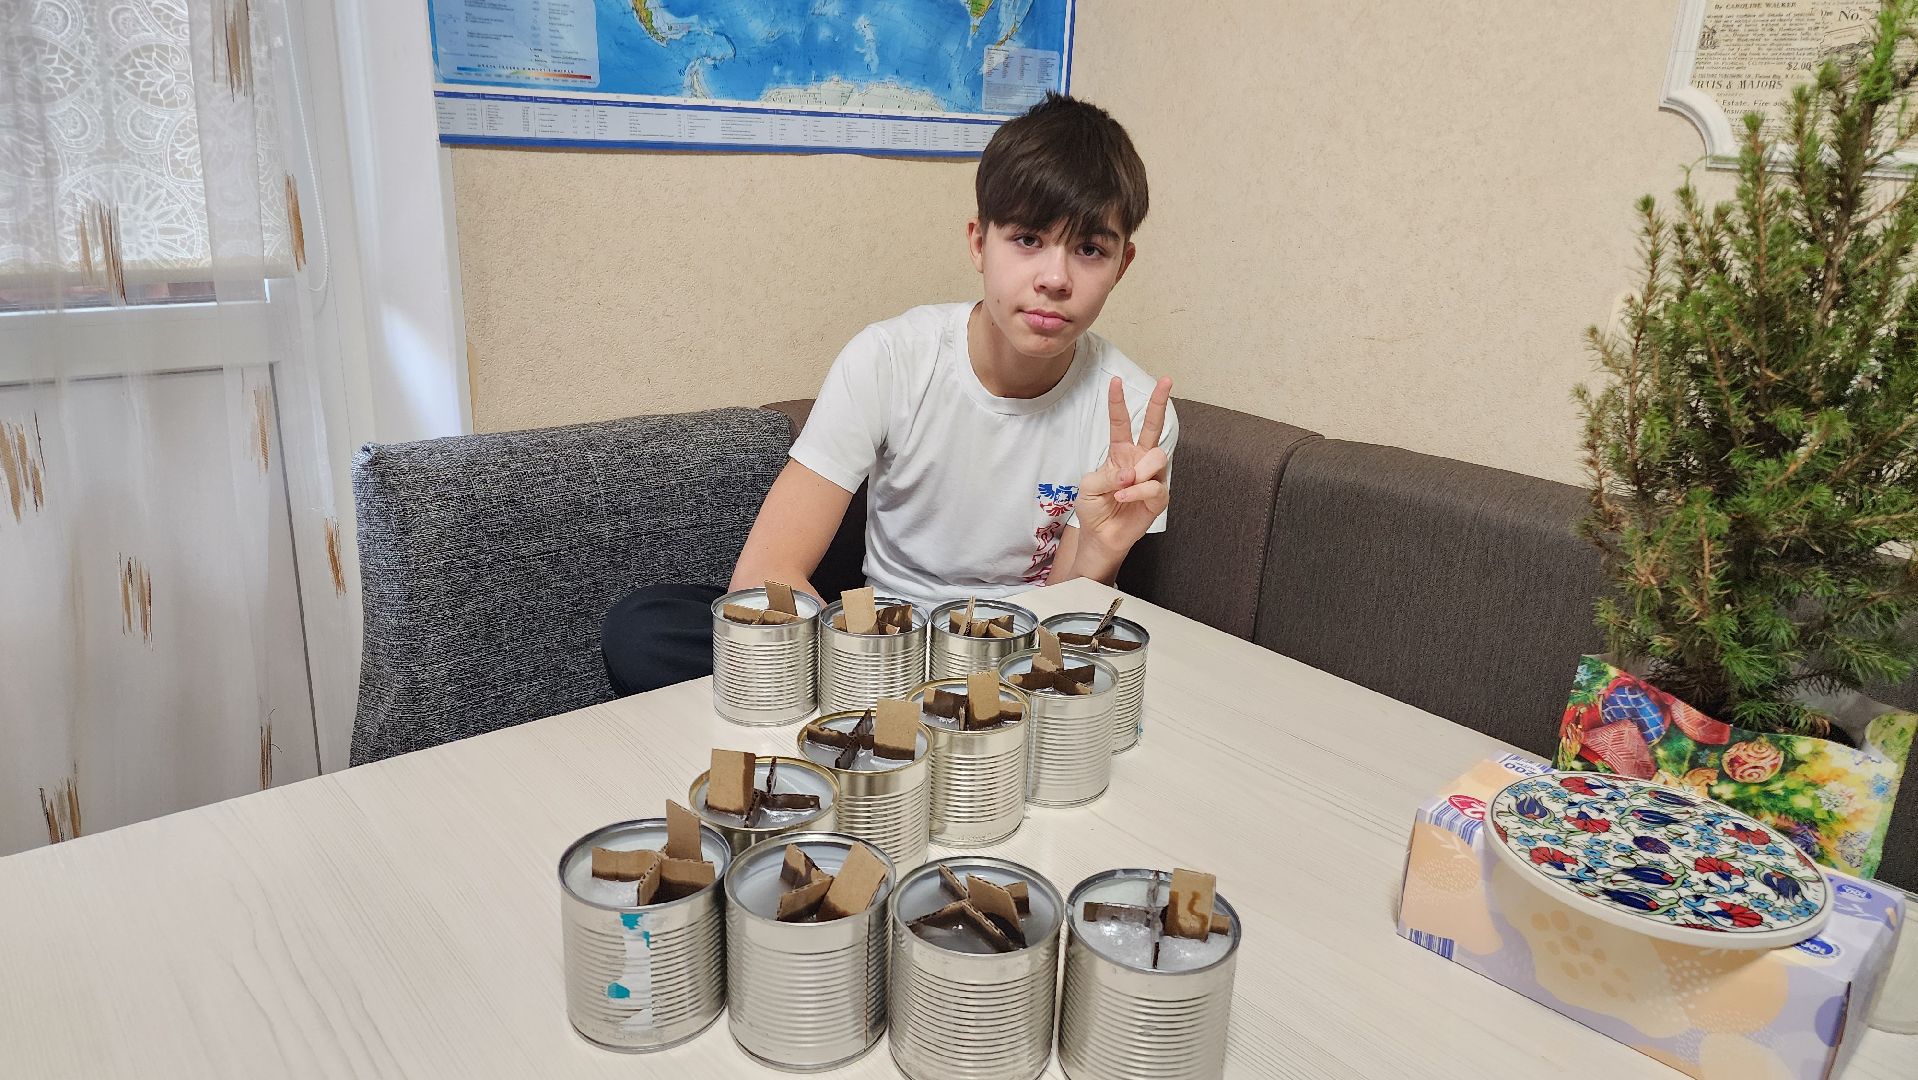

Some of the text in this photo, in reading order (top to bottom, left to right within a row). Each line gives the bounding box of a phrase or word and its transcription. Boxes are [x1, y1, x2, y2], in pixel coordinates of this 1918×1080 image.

[1838, 10, 1863, 21] No.
[1725, 81, 1732, 89] &
[1738, 80, 1783, 89] MAJORS
[1753, 99, 1769, 107] Fire
[1504, 762, 1537, 776] 200
